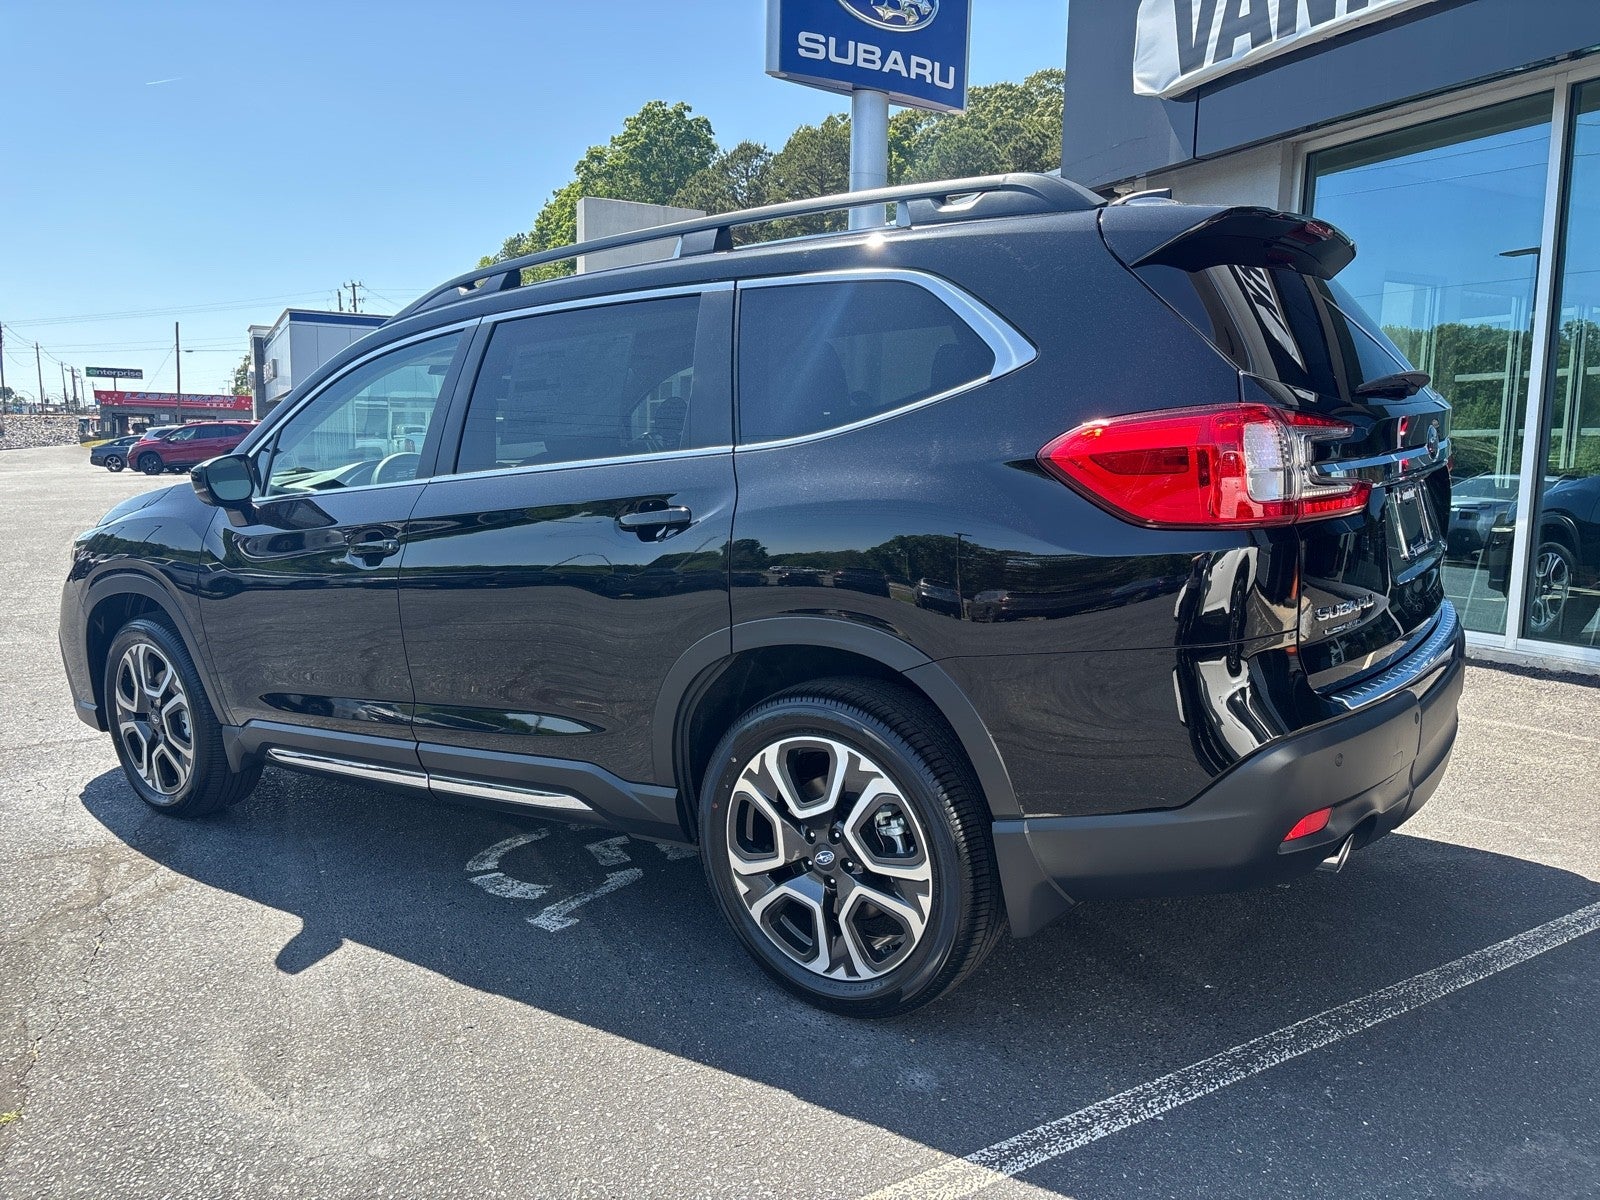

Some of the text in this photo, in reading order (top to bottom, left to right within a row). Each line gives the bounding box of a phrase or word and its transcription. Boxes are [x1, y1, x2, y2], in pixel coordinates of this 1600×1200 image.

[1174, 0, 1369, 76] VAN
[797, 31, 955, 90] SUBARU
[87, 368, 142, 378] enterprise
[1315, 593, 1375, 621] SUBARU
